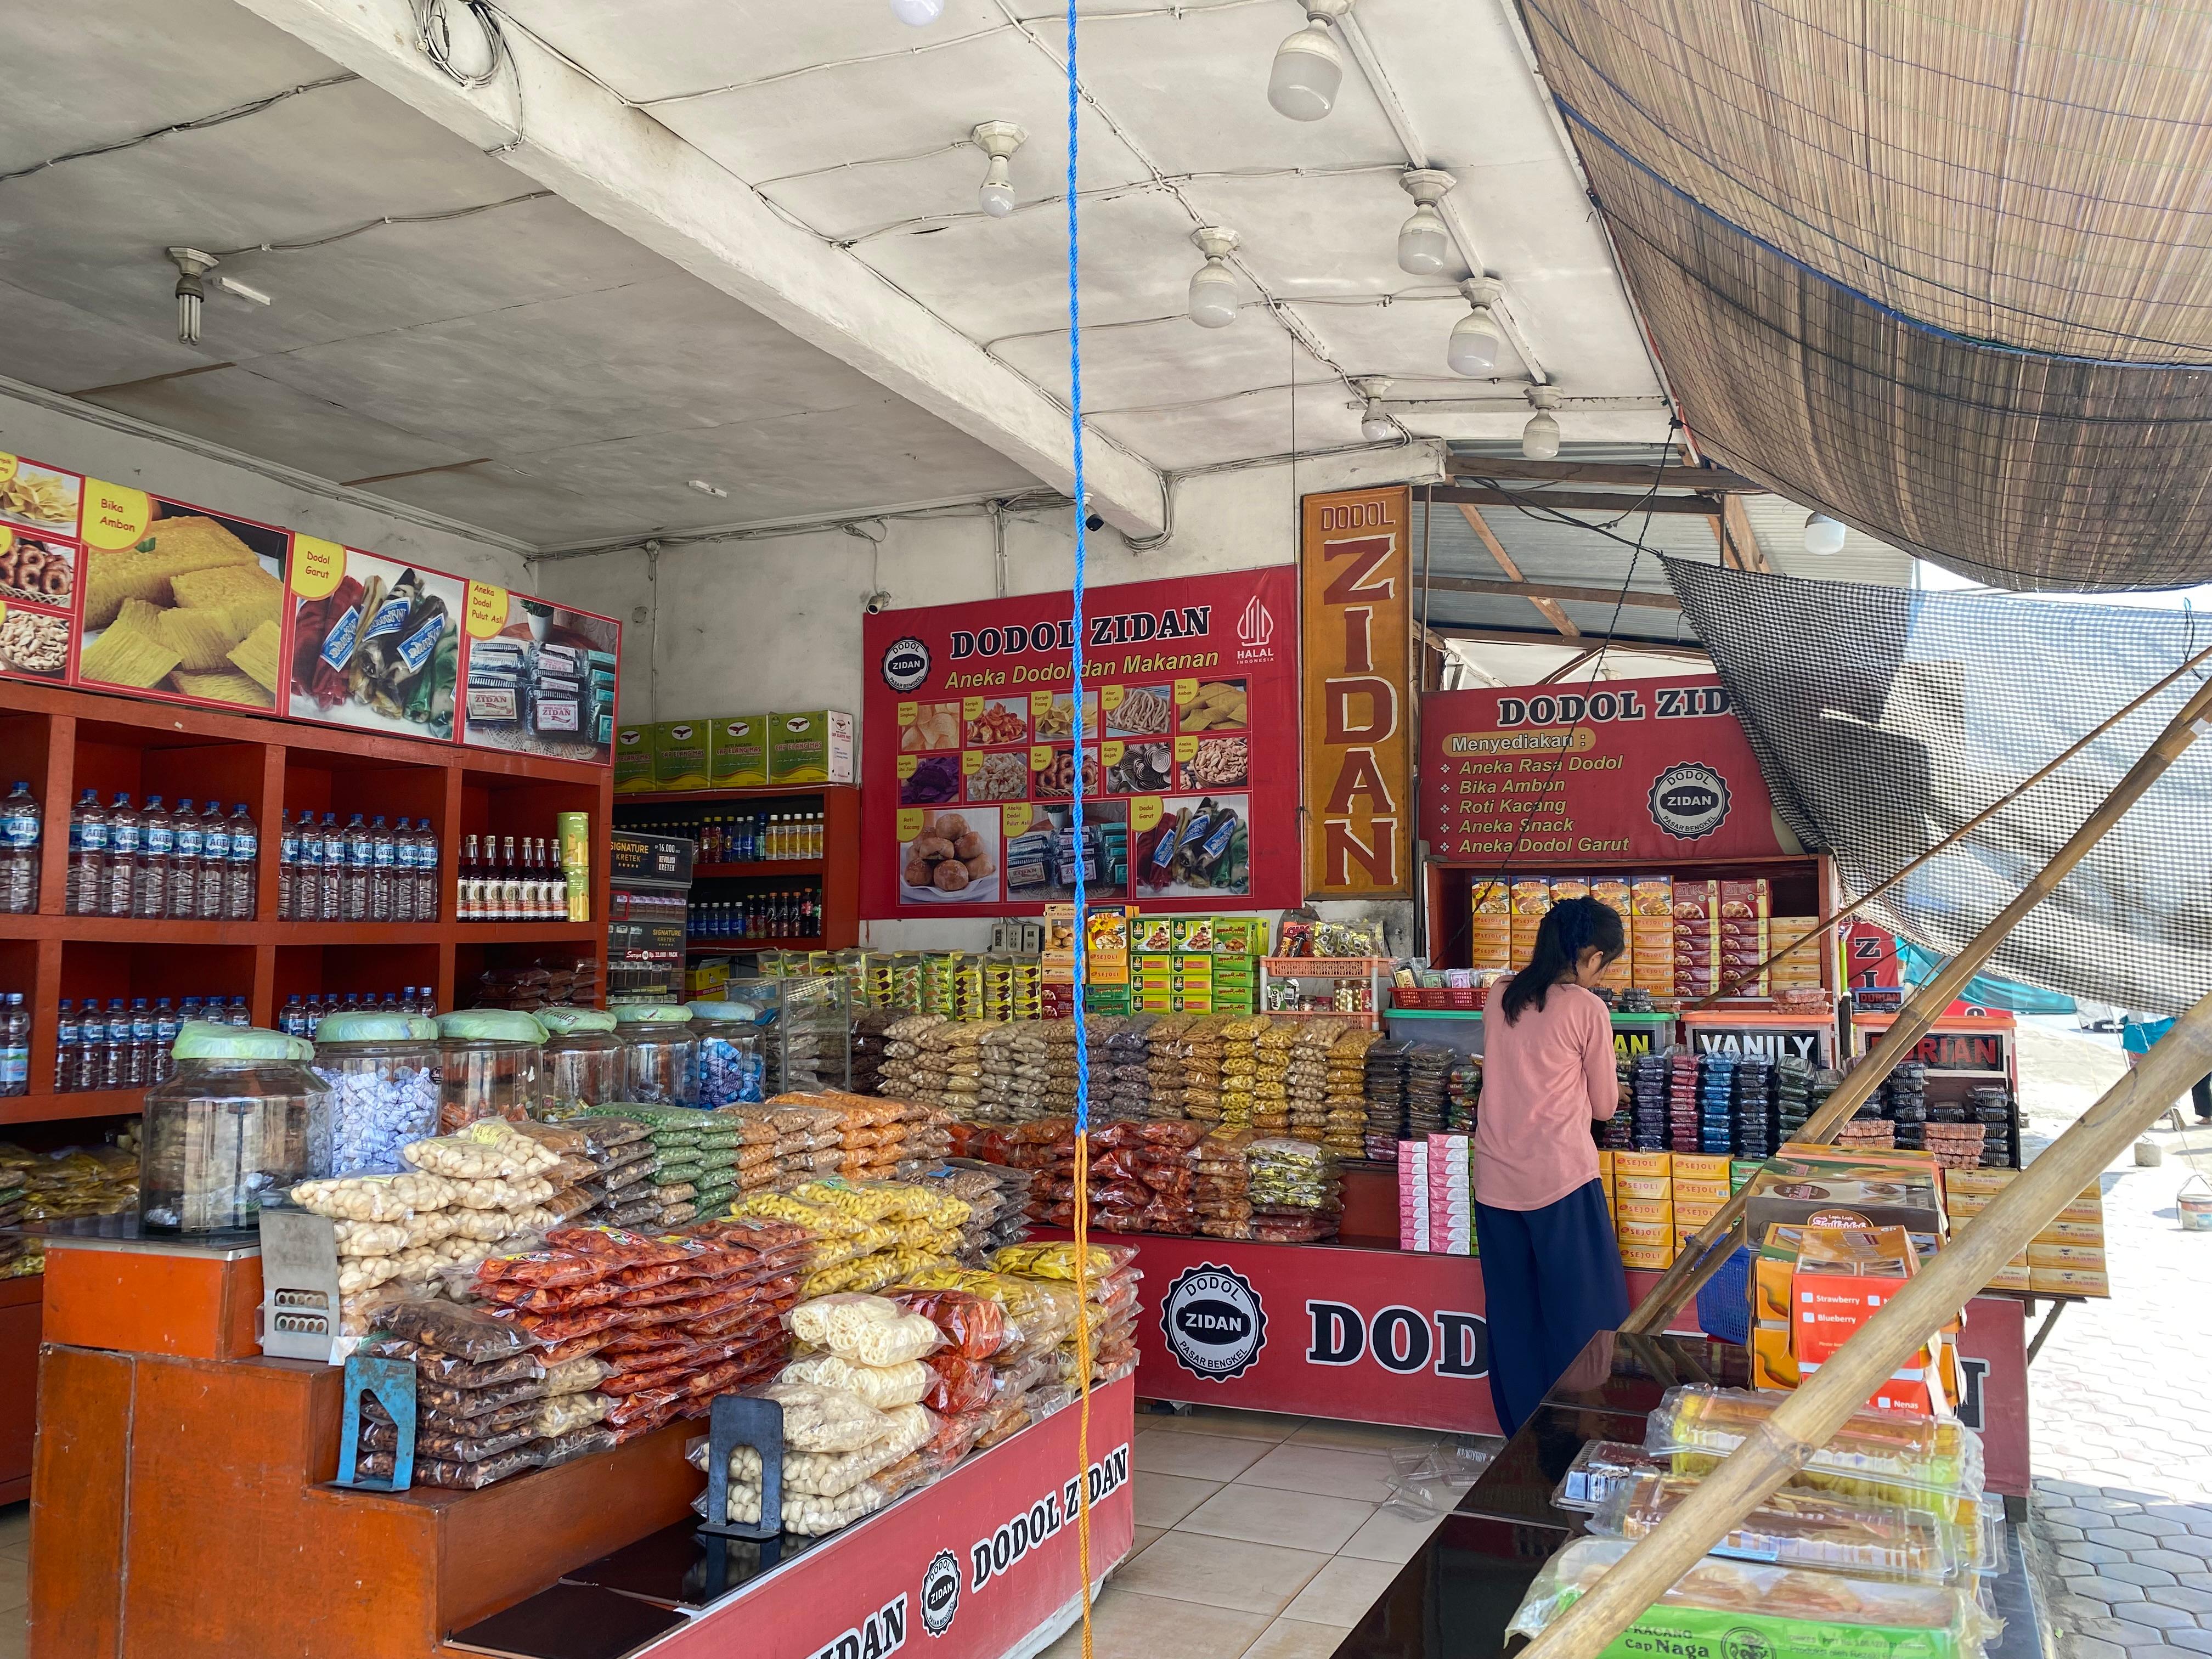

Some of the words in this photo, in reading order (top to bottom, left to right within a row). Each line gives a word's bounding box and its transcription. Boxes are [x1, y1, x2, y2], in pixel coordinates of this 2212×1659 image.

[100, 498, 124, 514] Bika
[1321, 500, 1396, 531] DODOL
[99, 516, 136, 533] Ambon
[307, 550, 330, 565] Dodol
[305, 566, 330, 579] Garut
[473, 584, 495, 597] Aneka
[472, 596, 492, 609] Dodol
[471, 609, 489, 621] Pulut
[490, 614, 504, 624] Asli
[950, 619, 1075, 660] DODOL
[1090, 605, 1212, 647] ZIDAN
[892, 641, 920, 655] DODOL
[1237, 647, 1274, 659] HALAL
[892, 660, 921, 670] ZIDAN
[944, 668, 1006, 690] Aneka
[1012, 661, 1074, 684] Dodol
[1080, 659, 1116, 678] dan
[1122, 651, 1219, 675] Makanan
[889, 676, 903, 689] PASAR
[902, 675, 924, 689] BENGKEL
[475, 696, 507, 704] ZIDAN
[1497, 690, 1646, 728] DODOL
[1655, 685, 1735, 720] ZID
[542, 708, 572, 716] ZIDAN
[1323, 532, 1399, 887] ZIDAN
[729, 747, 748, 755] ELANG
[788, 742, 808, 751] ELANG
[1452, 732, 1574, 755] Menyediakan
[1458, 760, 1514, 776] Aneka
[1518, 758, 1564, 774] Rasa
[1568, 754, 1624, 772] Dodol
[1666, 769, 1711, 787] DODOL
[1459, 779, 1497, 795] Bika
[1501, 777, 1566, 793] Ambon
[1459, 799, 1494, 815] Roti
[1499, 798, 1567, 815] Kacang
[1667, 795, 1712, 807] ZIDAN
[10, 821, 37, 834] AQUA
[1458, 819, 1513, 834] Aneka
[1519, 816, 1575, 833] Snack
[1662, 814, 1684, 832] PASAR
[1684, 814, 1718, 832] BENGKEL
[610, 840, 650, 854] SIGNATURE
[658, 843, 675, 854] 16.000
[1458, 838, 1514, 854] Aneka
[1518, 837, 1572, 854] Dodol
[1577, 836, 1630, 853] Garut
[616, 853, 641, 862] KRETEK
[658, 864, 675, 872] KRETEK
[1675, 884, 1703, 895] ATIK
[1724, 883, 1752, 895] ATIK
[1860, 992, 1900, 1003] DURIAN
[1700, 1035, 1815, 1060] VANILY
[1184, 1276, 1240, 1302] DODOL
[1816, 1295, 1860, 1305] Strawberry
[1185, 1313, 1243, 1333] ZIDAN
[1817, 1314, 1857, 1324] Blueberry
[1306, 1299, 1488, 1380] DOD
[1178, 1340, 1207, 1368] PASAR
[1207, 1347, 1248, 1369] BENGKEL
[1894, 1400, 1919, 1409] Nenas
[971, 1489, 1061, 1594] DODOL
[929, 1560, 951, 1582] DODOL
[930, 1581, 953, 1605] ZIDAN
[928, 1614, 940, 1626] PASAR
[1633, 1625, 1693, 1639] KACANG
[1625, 1639, 1652, 1651] Cap
[1655, 1639, 1709, 1659] Naga
